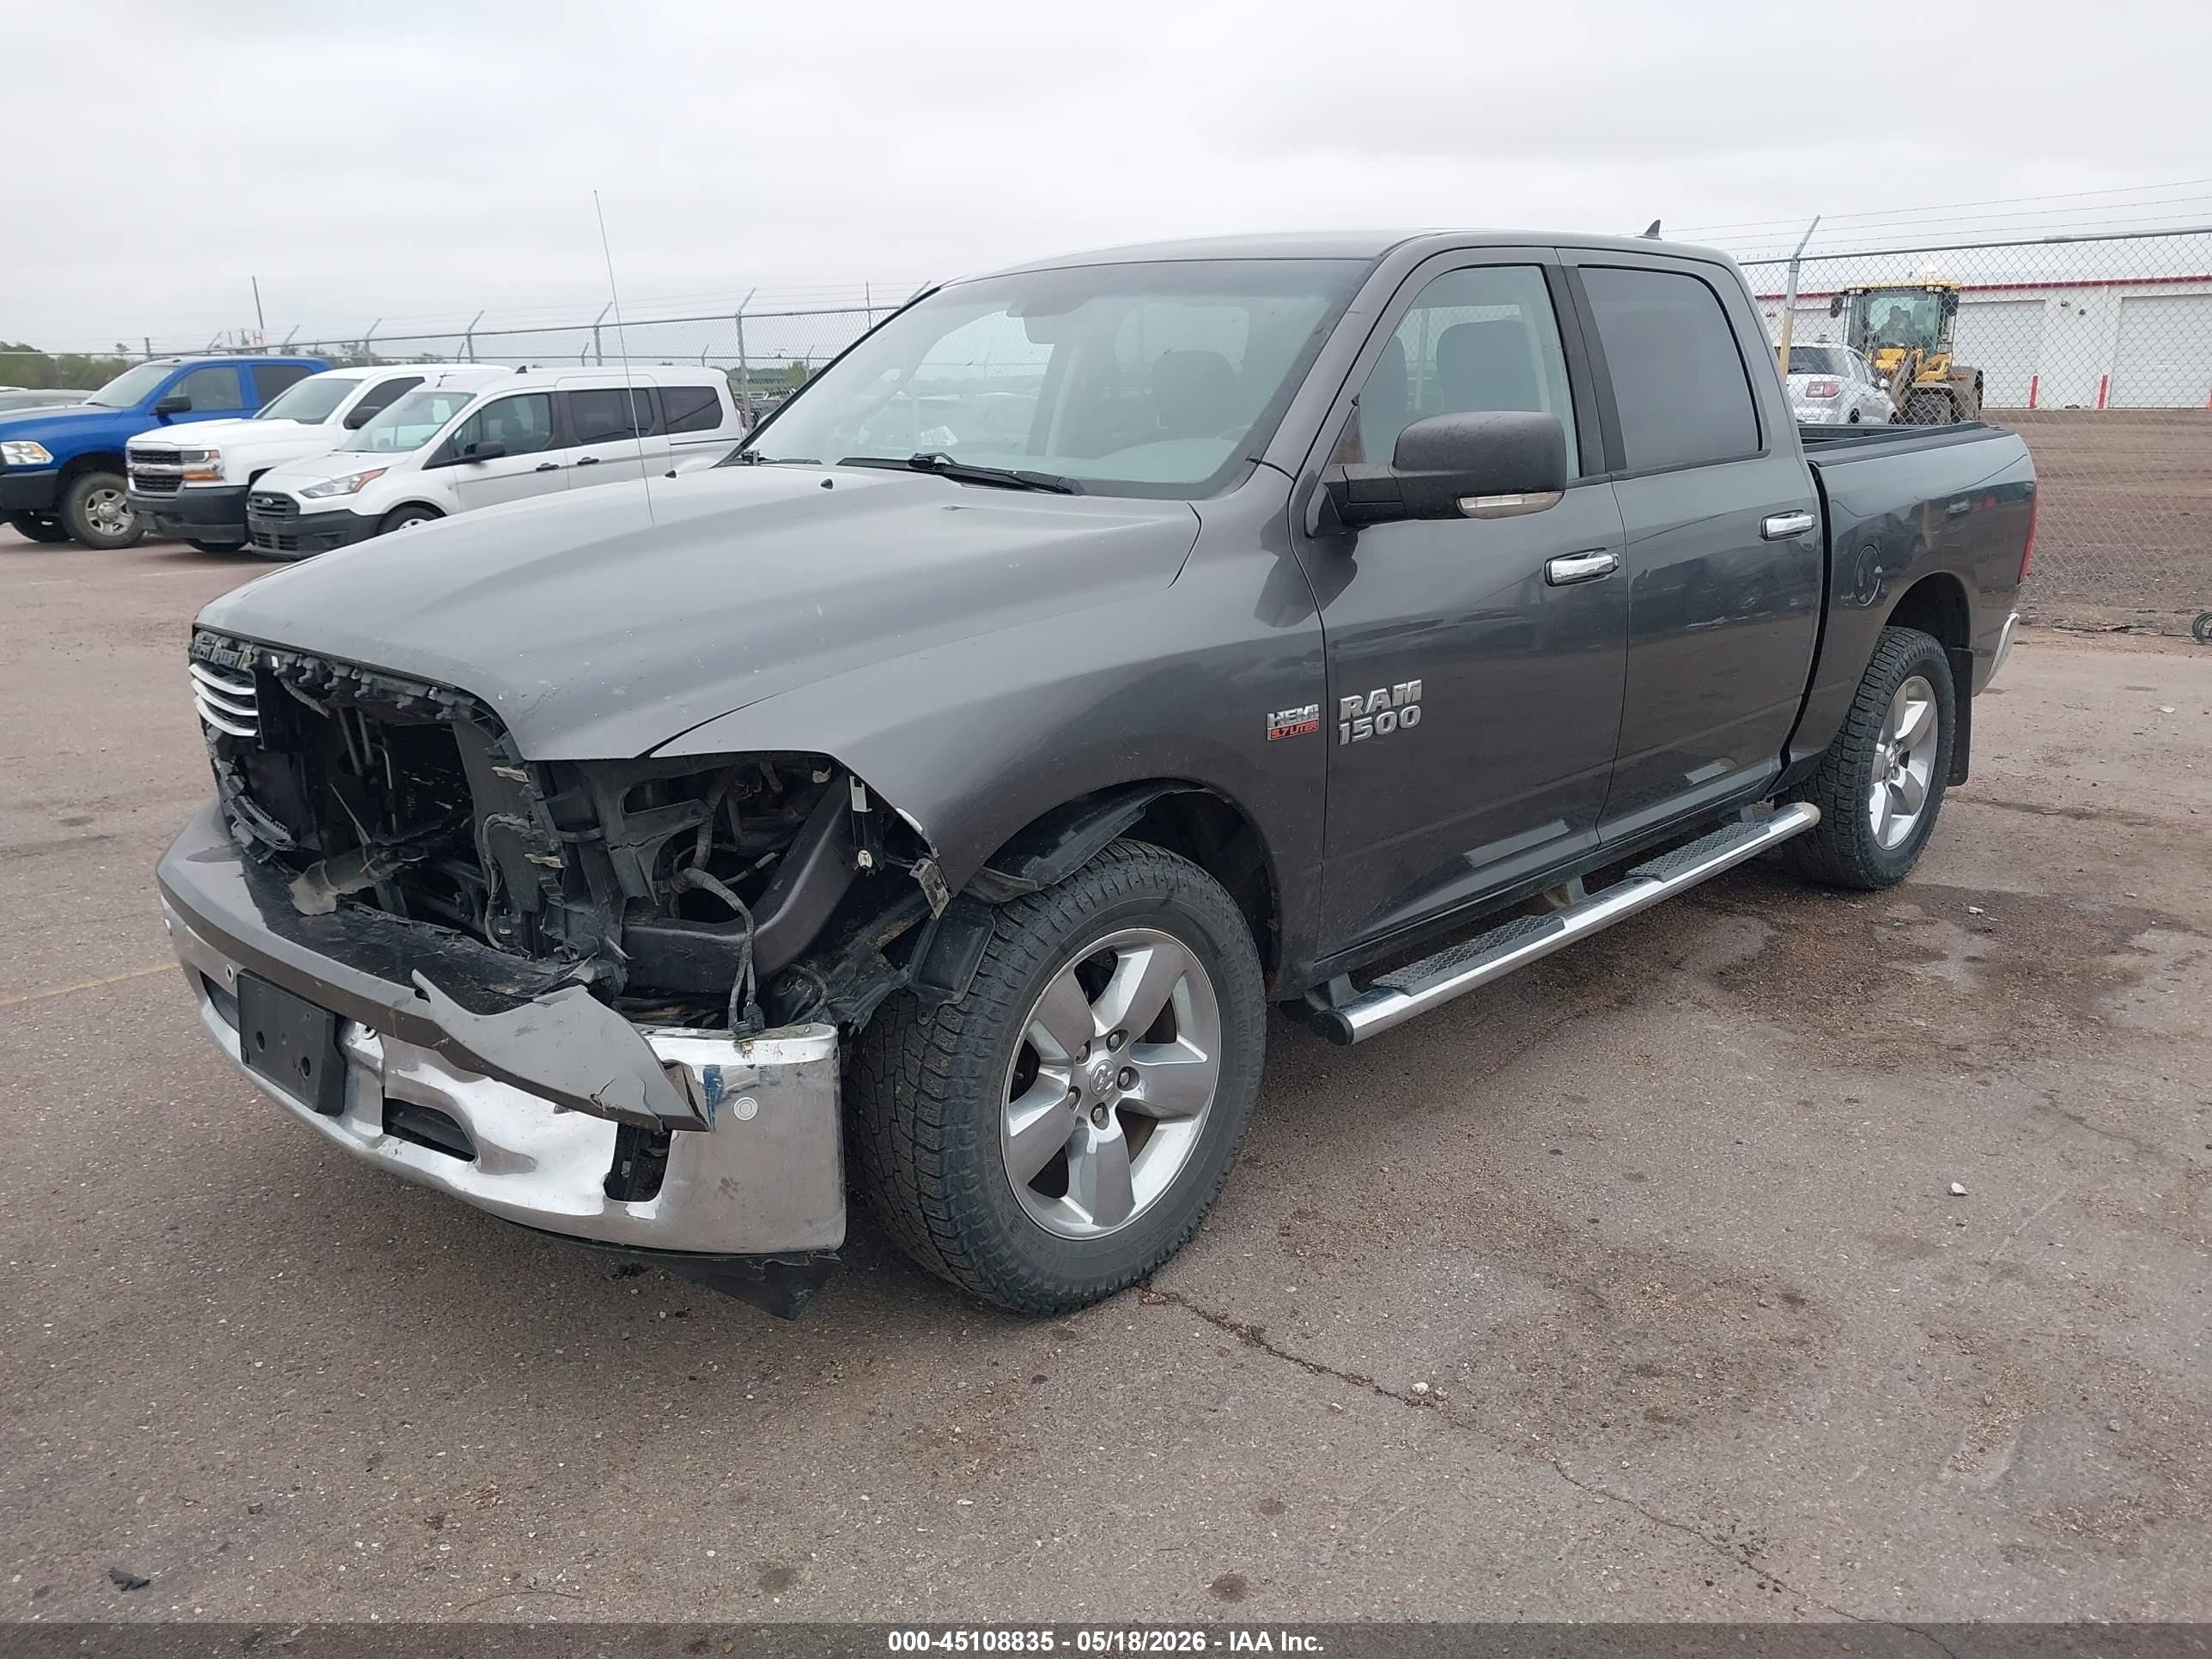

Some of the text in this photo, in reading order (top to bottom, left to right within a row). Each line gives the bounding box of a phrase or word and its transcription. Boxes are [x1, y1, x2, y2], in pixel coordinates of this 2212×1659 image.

[1267, 704, 1319, 728] HEMI
[1339, 679, 1422, 720] RAM
[1338, 705, 1422, 745] 1500
